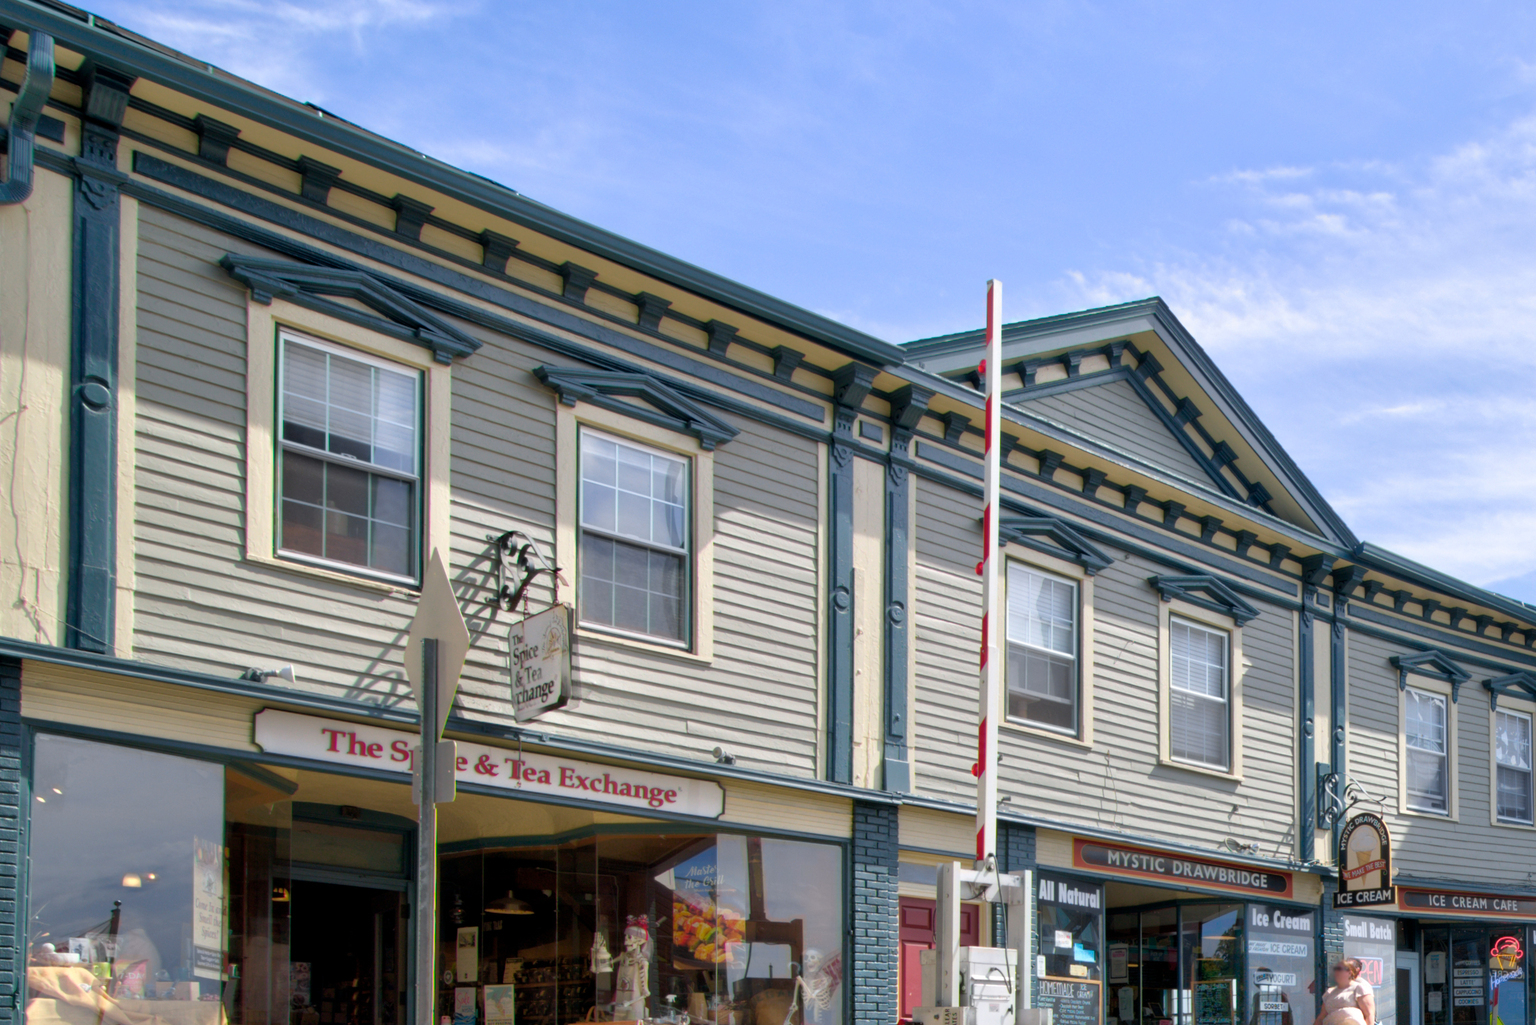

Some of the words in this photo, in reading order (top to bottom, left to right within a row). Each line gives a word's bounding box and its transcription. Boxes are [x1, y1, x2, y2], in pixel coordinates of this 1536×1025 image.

[513, 643, 538, 669] Spice
[515, 671, 523, 688] &
[524, 666, 542, 685] Tea
[322, 728, 384, 759] The
[474, 754, 499, 777] &
[504, 757, 552, 785] Tea
[558, 766, 677, 808] Exchange
[1340, 822, 1355, 851] MYSTIC
[1355, 815, 1388, 845] DRAWBRIDGE
[1107, 850, 1165, 873] MYSTIC
[1172, 860, 1268, 888] DRAWBRIDGE
[1351, 867, 1365, 877] MAKE
[1365, 863, 1374, 872] THE
[1374, 860, 1386, 869] BEST
[685, 878, 700, 889] the
[1038, 878, 1055, 901] All
[1058, 882, 1100, 909] Natural
[1337, 892, 1353, 905] ICE
[1356, 889, 1392, 903] CREAM
[1428, 894, 1446, 907] ICE
[1452, 896, 1487, 910] CREAM
[1493, 899, 1518, 911] CAFE
[1252, 907, 1269, 928] Ice
[1273, 910, 1311, 931] Cream
[1345, 919, 1368, 938] Small
[1369, 922, 1392, 941] Batch
[1270, 943, 1280, 953] ICE
[1281, 944, 1306, 955] CREAM
[1269, 973, 1294, 984] YOGURT
[1360, 959, 1383, 986] PEN
[1039, 980, 1075, 997] HOMEMADE
